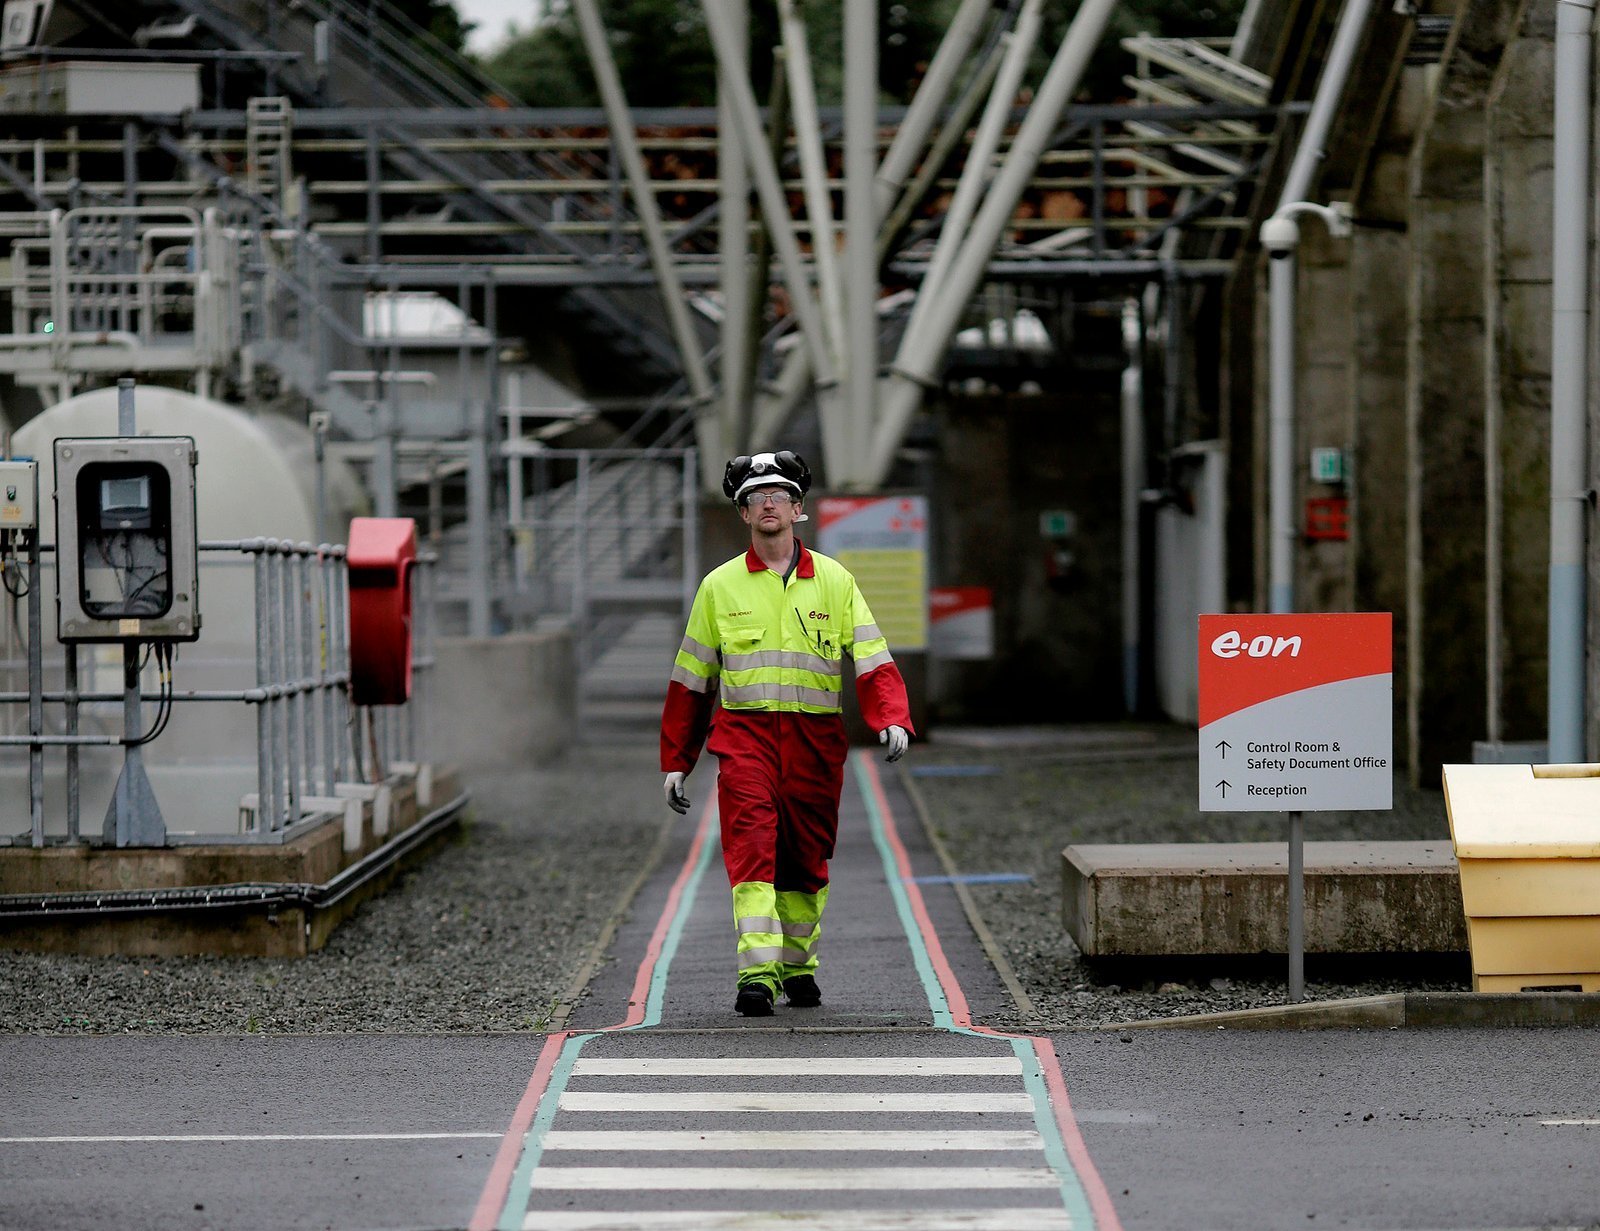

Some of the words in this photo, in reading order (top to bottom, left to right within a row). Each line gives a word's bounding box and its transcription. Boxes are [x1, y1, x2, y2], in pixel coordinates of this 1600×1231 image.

[1247, 741, 1291, 753] Control
[1294, 741, 1329, 753] Room
[1332, 741, 1341, 752] &
[1247, 758, 1286, 772] Safety
[1289, 758, 1350, 769] Document
[1353, 756, 1387, 768] Office
[1247, 784, 1307, 798] Reception
